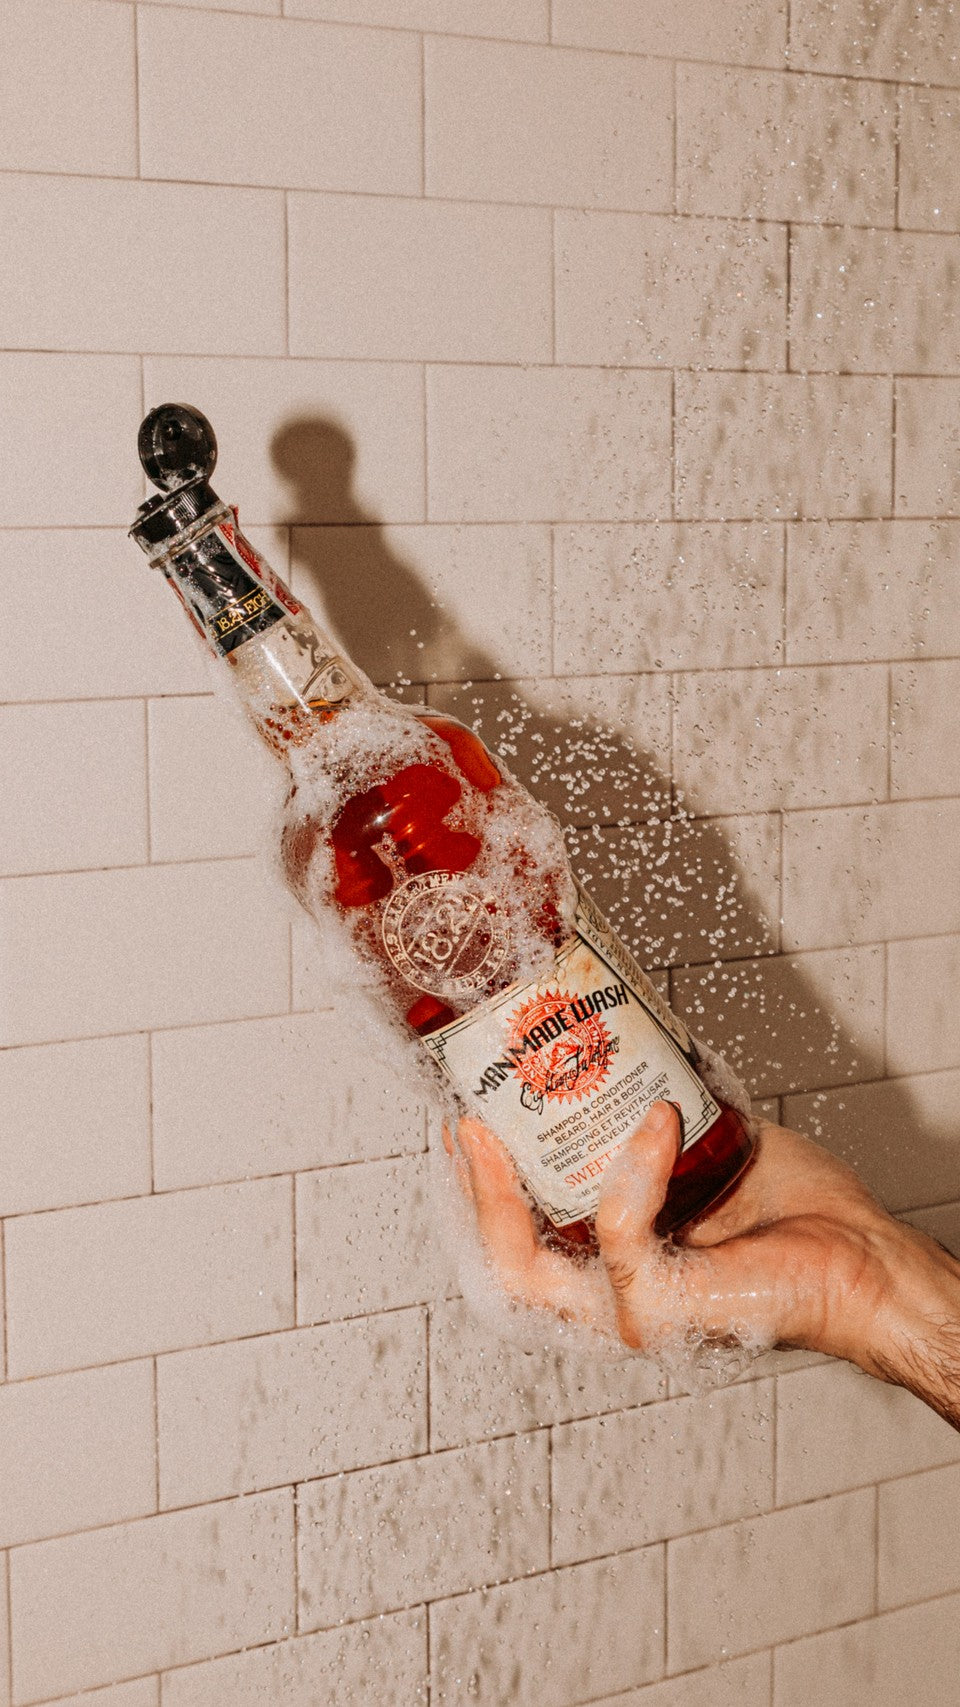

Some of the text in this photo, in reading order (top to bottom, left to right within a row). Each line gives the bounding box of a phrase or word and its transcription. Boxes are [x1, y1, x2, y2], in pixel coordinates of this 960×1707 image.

[216, 610, 243, 631] 18.21
[473, 1053, 518, 1103] MAN
[509, 1009, 574, 1063] MADE
[571, 984, 629, 1023] WASH
[537, 1061, 649, 1143] SHAMPOO & CONDITIONER
[540, 1072, 670, 1168] SHAMPOOING ET REVITALISANT
[590, 1104, 613, 1123] HAIR
[613, 1098, 621, 1107] &
[621, 1078, 645, 1100] BODY
[587, 1121, 630, 1152] CHEVEUX
